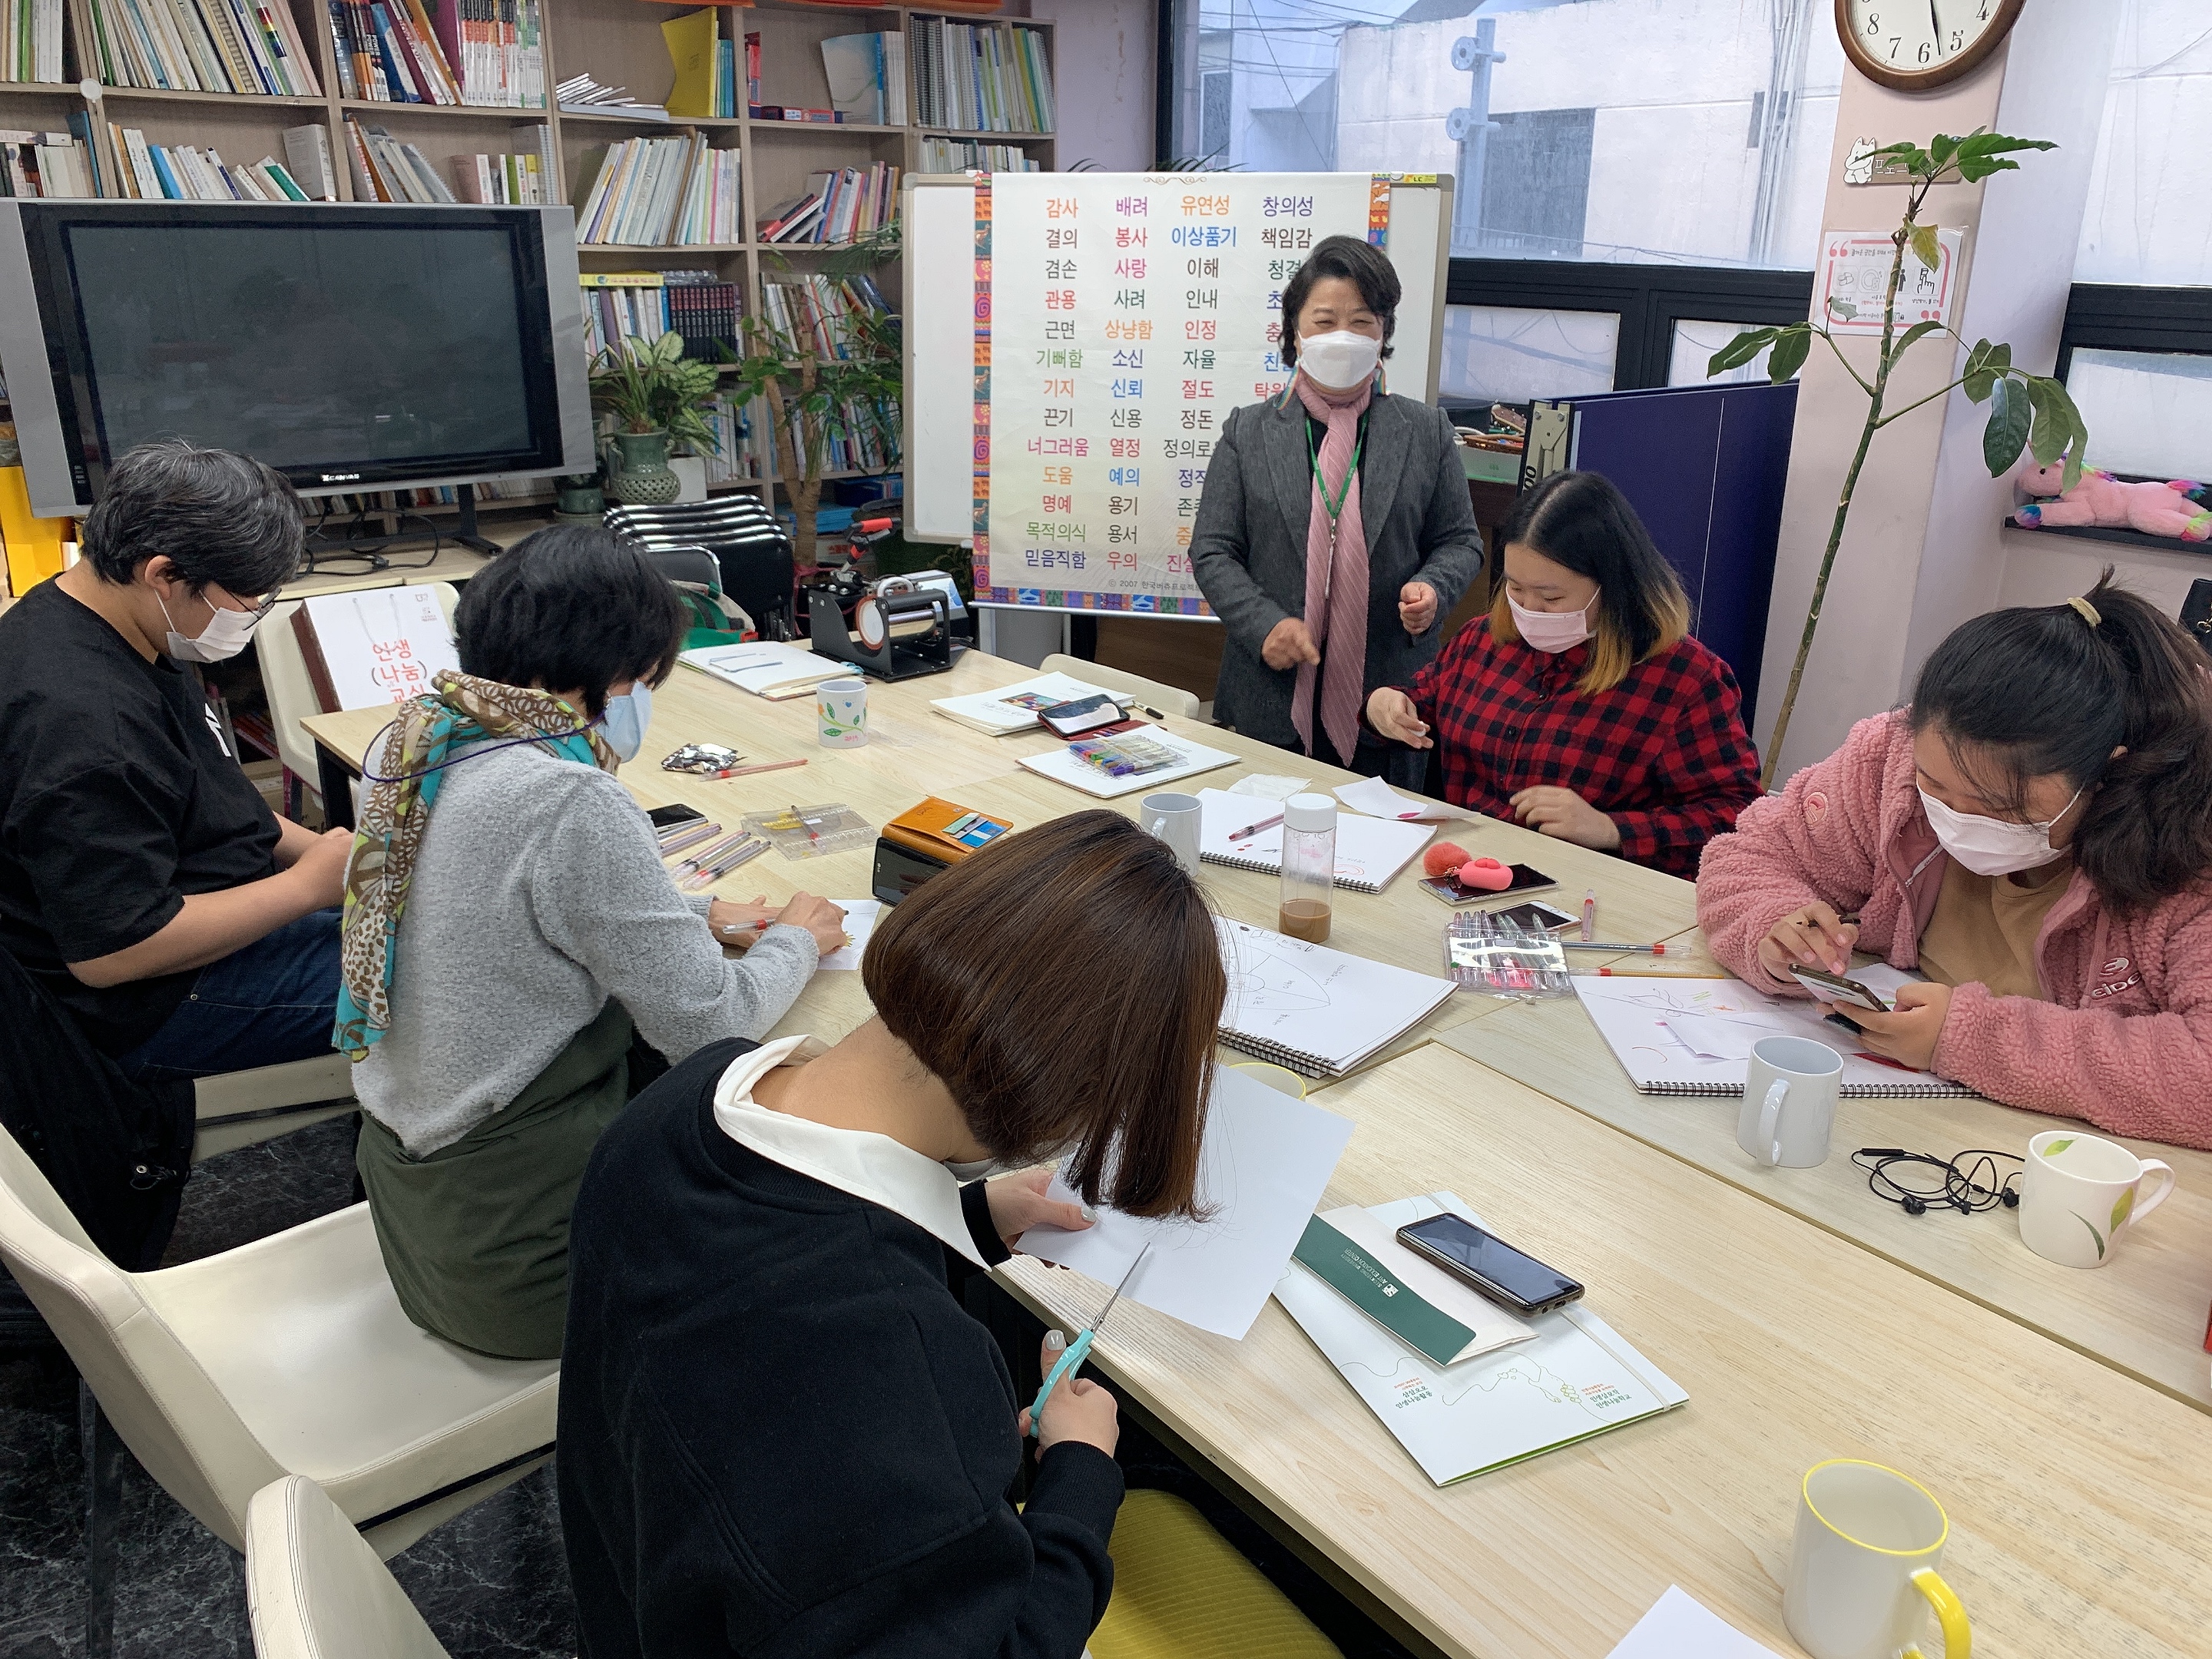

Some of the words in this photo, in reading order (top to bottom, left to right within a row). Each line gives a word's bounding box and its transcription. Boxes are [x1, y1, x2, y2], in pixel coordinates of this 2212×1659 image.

[1867, 13, 1879, 35] 8
[372, 35, 381, 56] POWER
[1889, 37, 1902, 59] 7
[1950, 30, 1964, 51] 5
[1918, 42, 1931, 64] 6
[1047, 198, 1078, 218] 감사
[1117, 197, 1147, 217] 배려
[1181, 196, 1229, 215] 유연성
[1263, 196, 1313, 217] 창의성
[1047, 229, 1077, 248] 결의
[1116, 227, 1147, 247] 봉사
[1172, 227, 1236, 247] 이상품기
[1262, 227, 1312, 248] 책임감
[1046, 260, 1077, 279] 겸손
[1115, 259, 1146, 278] 사랑
[1187, 258, 1218, 278] 이해
[1046, 290, 1075, 310] 관용
[1114, 290, 1144, 309] 사려
[1187, 289, 1217, 309] 인내
[1045, 320, 1074, 339] 근면
[1106, 320, 1152, 339] 상냥함
[1186, 320, 1216, 339] 인정
[1037, 349, 1081, 368] 기뻐함
[1113, 349, 1143, 368] 소신
[1183, 349, 1216, 369] 자율
[1045, 379, 1073, 397] 기지
[1111, 379, 1142, 398] 신뢰
[1182, 380, 1214, 399] 절도
[1045, 409, 1072, 427] 끈기
[1111, 409, 1141, 428] 신용
[1181, 410, 1213, 429] 정돈
[1028, 437, 1088, 456] 너그러움
[1111, 439, 1140, 457] 열정
[1164, 439, 1218, 459] 정의로
[1044, 467, 1072, 485] 도움
[1110, 468, 1139, 485] 예의
[1043, 495, 1071, 513] 명예
[1109, 496, 1137, 515] 용기
[1027, 522, 1085, 542] 목적의식
[1108, 525, 1137, 544] 용서
[1026, 549, 1086, 569] 믿음직함
[1108, 552, 1136, 571] 우의
[373, 639, 411, 661] 인생
[372, 661, 427, 687] (나눔)
[1344, 1247, 1360, 1261] CENTER
[1359, 1258, 1380, 1277] EDUCATION
[1377, 1276, 1388, 1284] ART
[1396, 1390, 1433, 1409] 인생나눔활동
[1402, 1386, 1429, 1398] 삼삼오오
[1596, 1394, 1633, 1409] 인생나눔학교
